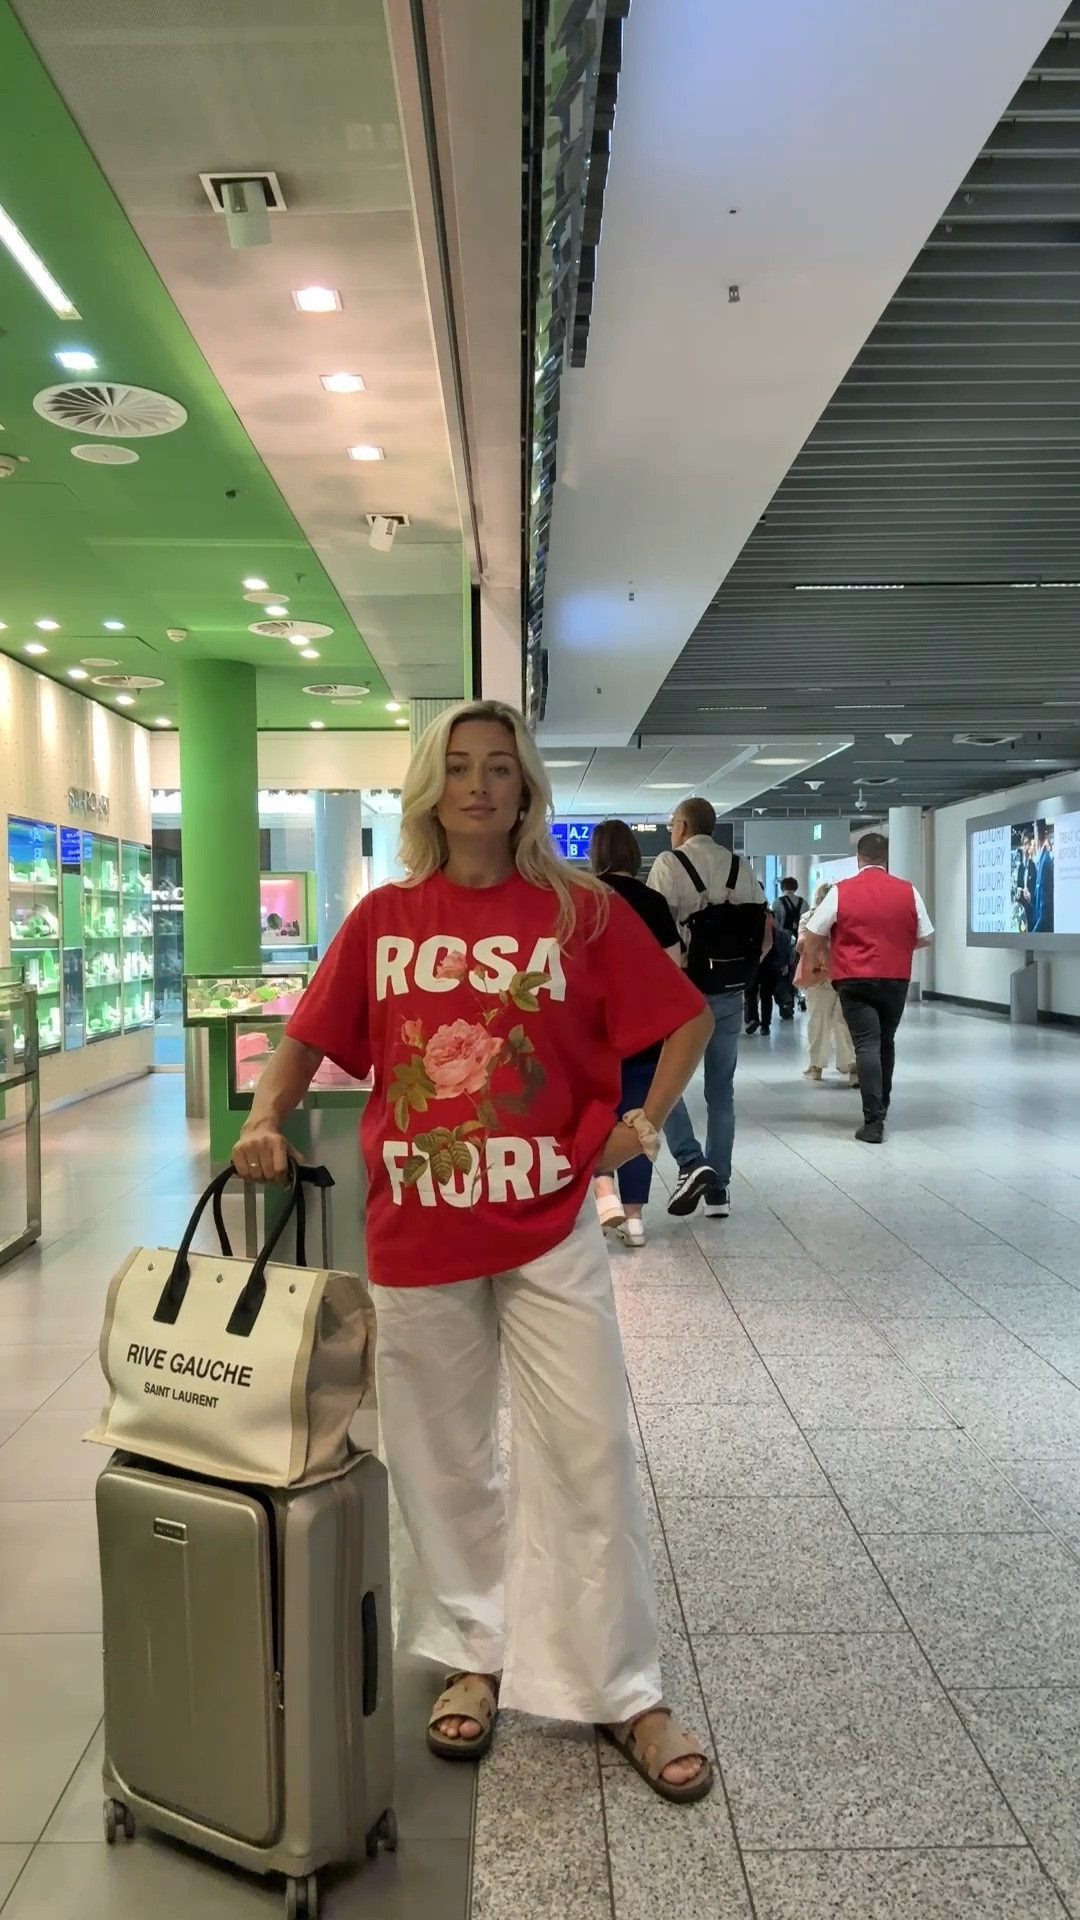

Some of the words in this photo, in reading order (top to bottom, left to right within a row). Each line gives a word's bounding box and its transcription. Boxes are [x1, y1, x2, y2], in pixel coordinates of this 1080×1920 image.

[570, 843, 578, 856] B
[978, 846, 1005, 867] LUXURY
[978, 870, 1006, 891] LUXURY
[978, 895, 1006, 914] LUXURY
[375, 934, 567, 1002] ROSA
[382, 1136, 574, 1208] FIORE
[127, 1343, 167, 1370] RIVE
[169, 1353, 254, 1387] GAUCHE
[144, 1382, 170, 1398] SAINT
[172, 1389, 219, 1408] LAURENT
